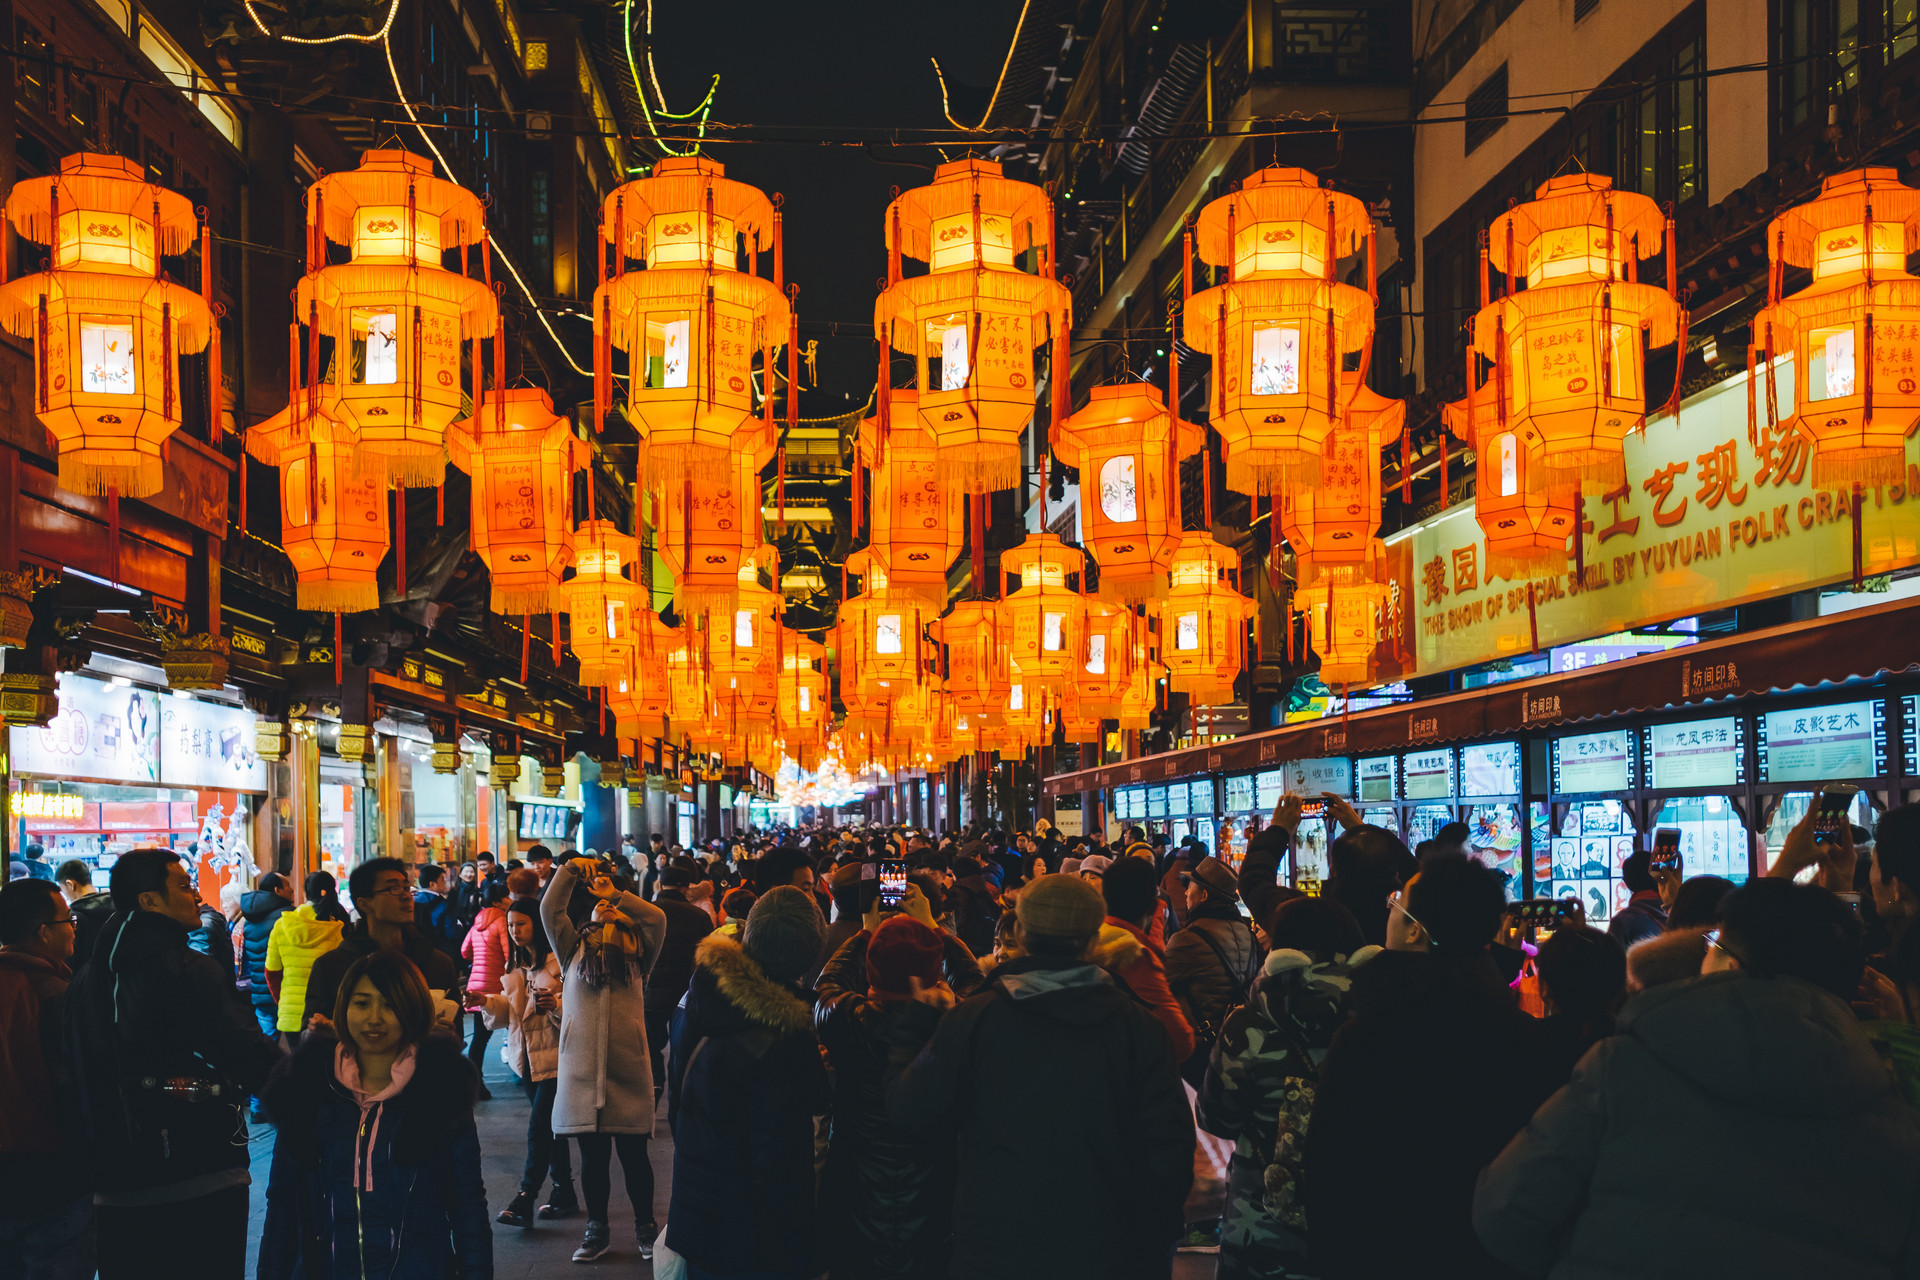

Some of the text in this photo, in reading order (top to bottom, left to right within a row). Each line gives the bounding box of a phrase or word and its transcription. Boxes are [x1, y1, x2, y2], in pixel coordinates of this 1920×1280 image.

[985, 311, 1024, 333] 大可不
[985, 336, 1024, 355] 必害怕
[1533, 328, 1585, 351] 保卫珍宝
[1543, 350, 1581, 371] 岛之战
[1011, 376, 1025, 386] 80
[1570, 380, 1585, 390] 199
[1899, 381, 1914, 391] 81
[899, 491, 940, 508] 半导体
[1421, 418, 1811, 607] 豫园工艺现场
[1423, 612, 1446, 636] THE
[1448, 600, 1483, 631] SHOW
[1486, 593, 1503, 618] OF
[1613, 551, 1636, 584] BY
[1640, 526, 1721, 577] YUYUAN
[1729, 503, 1790, 551] FOLK
[1562, 651, 1587, 671] 3F
[1692, 661, 1738, 687] 坊间印象
[1530, 695, 1561, 715] 坊间印象
[1794, 711, 1860, 734] 皮影艺术
[1578, 738, 1619, 755] 艺术剪影
[1675, 728, 1728, 746] 龙凤书法
[1312, 766, 1344, 779] 收银台
